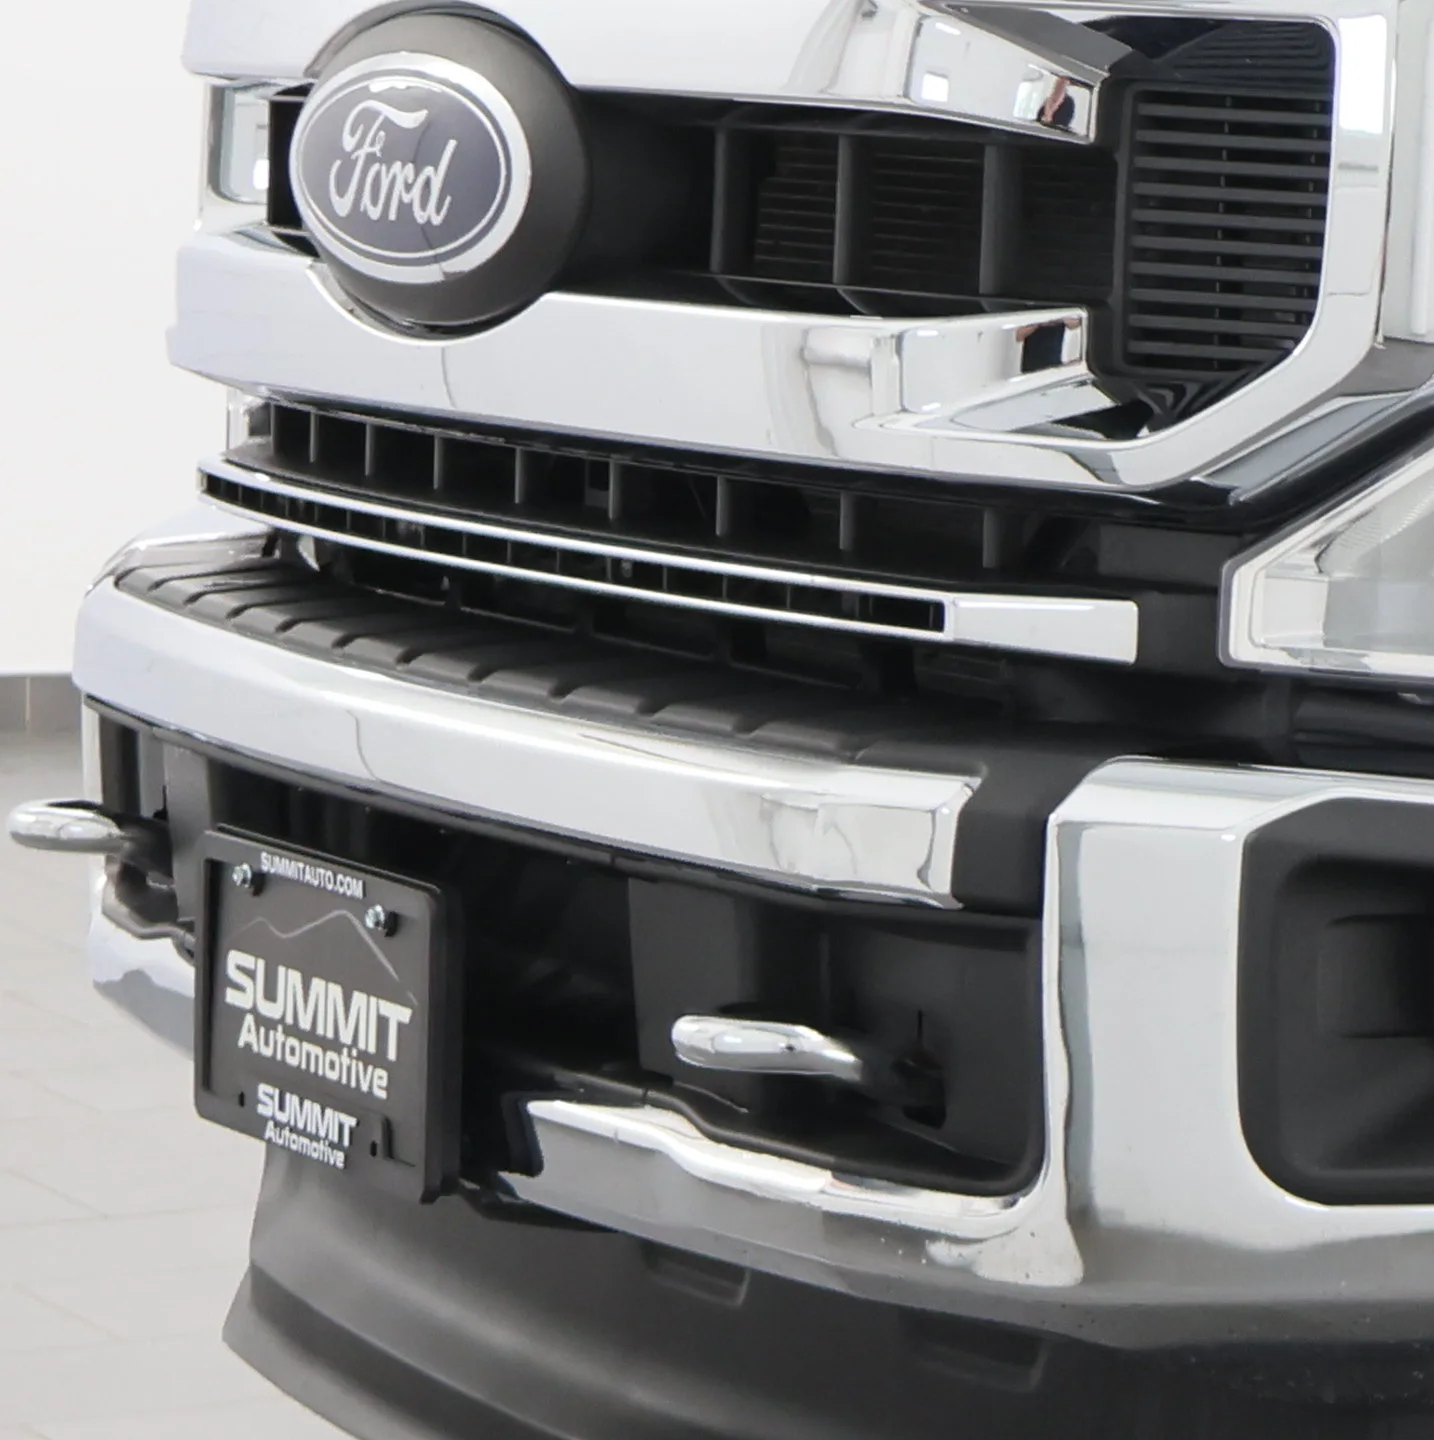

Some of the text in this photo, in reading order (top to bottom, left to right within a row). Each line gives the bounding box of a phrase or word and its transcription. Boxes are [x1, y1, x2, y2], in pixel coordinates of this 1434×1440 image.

[329, 100, 458, 226] Ford
[261, 852, 364, 900] SUMMITAUTO.COM
[225, 950, 412, 1061] SUMMIT
[238, 1014, 389, 1099] Automotive
[256, 1082, 357, 1147] SUMMIT
[264, 1120, 346, 1169] Automotive
